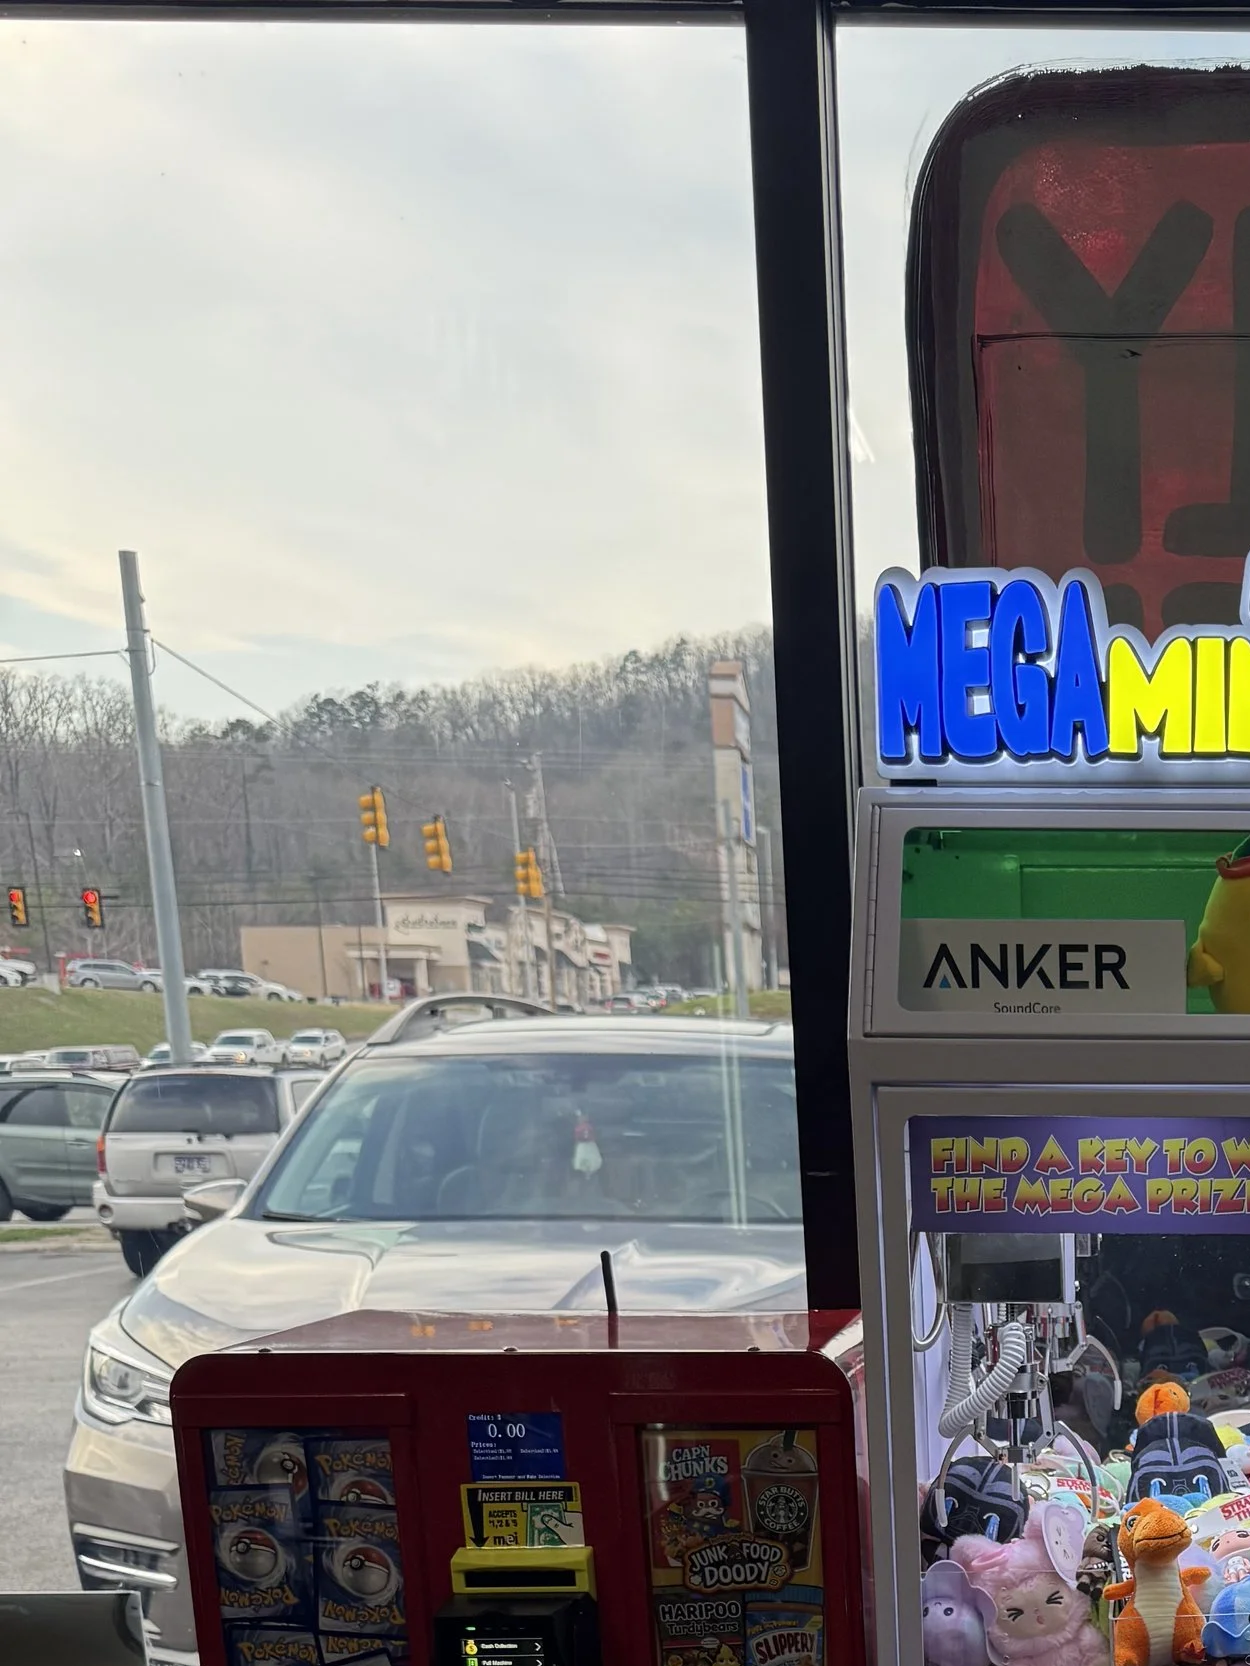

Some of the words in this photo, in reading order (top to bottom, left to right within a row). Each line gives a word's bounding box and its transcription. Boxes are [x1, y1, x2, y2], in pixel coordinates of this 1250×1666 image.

[877, 579, 1110, 762] MEGA
[923, 943, 1131, 990] ANKER
[993, 1001, 1061, 1014] SoundCore
[931, 1135, 1030, 1175] FIND
[1033, 1134, 1075, 1176] A
[1078, 1135, 1160, 1176] KEY
[1162, 1137, 1218, 1174] TO
[931, 1176, 1008, 1214] THE
[1012, 1175, 1142, 1217] MEGA
[662, 1456, 728, 1482] CHUNKS
[478, 1489, 513, 1502] INSERT
[515, 1491, 536, 1501] BILL
[538, 1490, 564, 1501] HERE
[493, 1532, 518, 1546] mei
[689, 1543, 729, 1572] JUNK
[742, 1542, 782, 1563] FOOD
[704, 1561, 770, 1587] DOODY
[660, 1600, 741, 1622] HARIPOO
[666, 1622, 739, 1637] Turdybears
[754, 1630, 816, 1665] SLIPPERY
